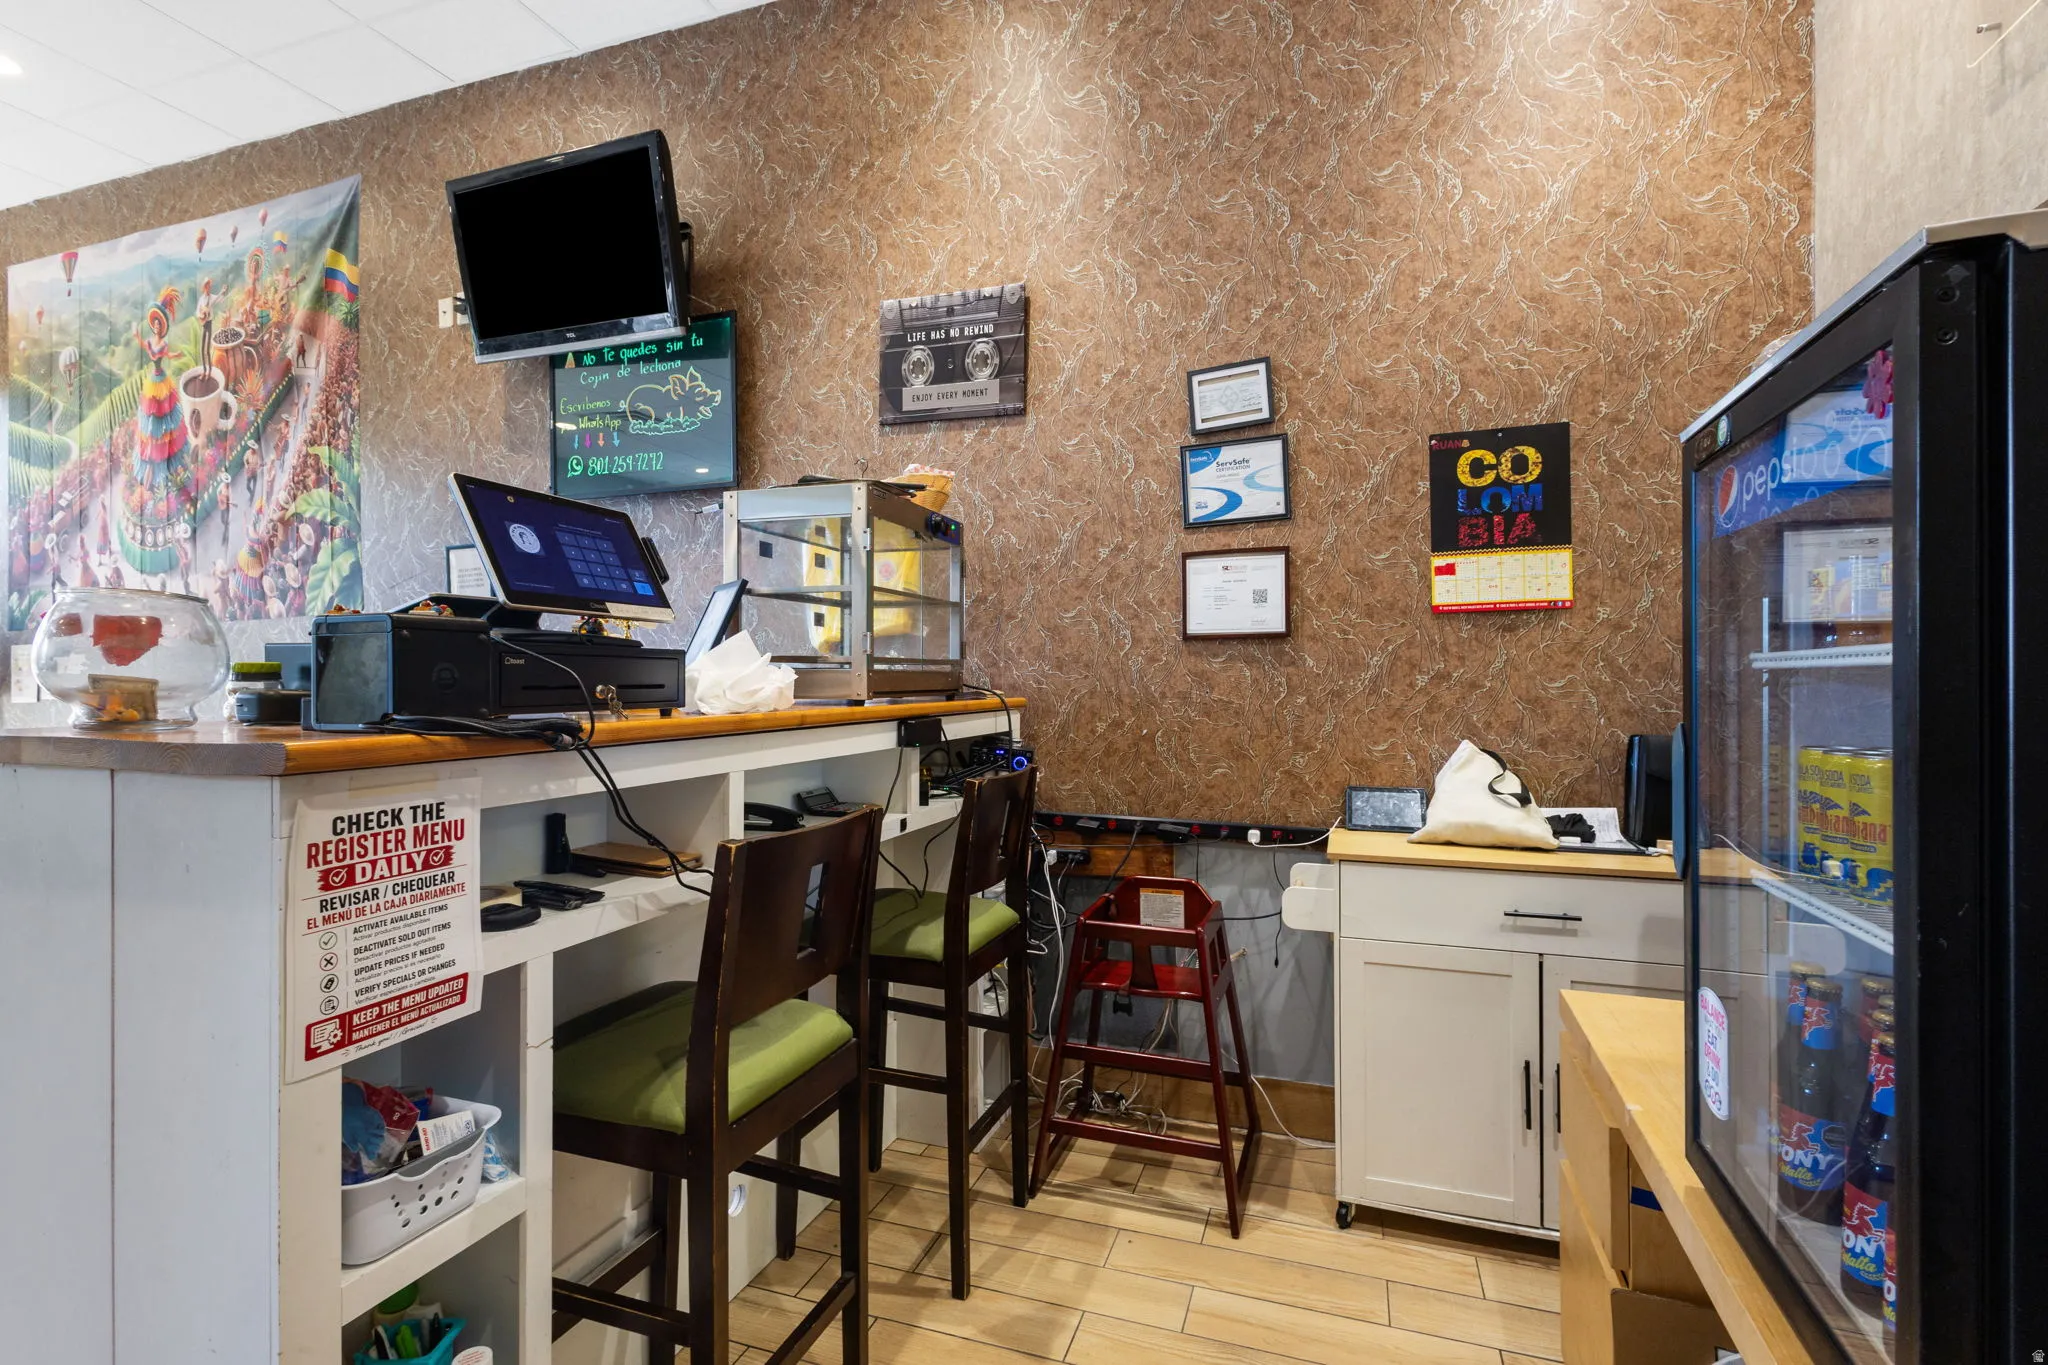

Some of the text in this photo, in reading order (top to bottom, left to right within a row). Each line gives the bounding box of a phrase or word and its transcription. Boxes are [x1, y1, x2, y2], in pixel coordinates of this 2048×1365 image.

[582, 354, 596, 366] No
[620, 342, 657, 366] quedes
[666, 339, 683, 353] sin
[691, 333, 704, 347] tu
[907, 323, 994, 343] LIFE HAS NO REWIND
[616, 364, 631, 378] de
[640, 359, 682, 375] lechona
[911, 387, 989, 403] ENJOY EVERY MOMENT
[1215, 457, 1250, 468] ServSafe
[1215, 464, 1251, 473] CERTIFICATION
[1456, 445, 1543, 487] CO
[1743, 437, 1797, 512] pepsi
[1456, 483, 1544, 515] LOM
[1456, 512, 1537, 547] BIA
[332, 801, 446, 837] CHECK THE
[306, 818, 465, 869] REGISTER MENU
[355, 851, 427, 884] DAILY
[307, 882, 466, 930] EL MENÚ DE LA CAJA DIARIAMENTE
[319, 871, 456, 913] REVISAR / CHEQUEAR
[353, 904, 449, 934] ACTIVATE AVAILABLE ITEMS
[353, 922, 451, 956] DEACTIVATE SOLD OUT ITEMS
[354, 943, 445, 976] UPDATE PRICES IF NEEDED
[354, 958, 456, 997] VERIFY SPECIALS OR CHANGES
[352, 978, 464, 1025] KEEP THE MENU UPDATED
[352, 994, 460, 1041] MANTENER EL MENÚ ACTUALIZADO
[1780, 1143, 1836, 1170] ONY
